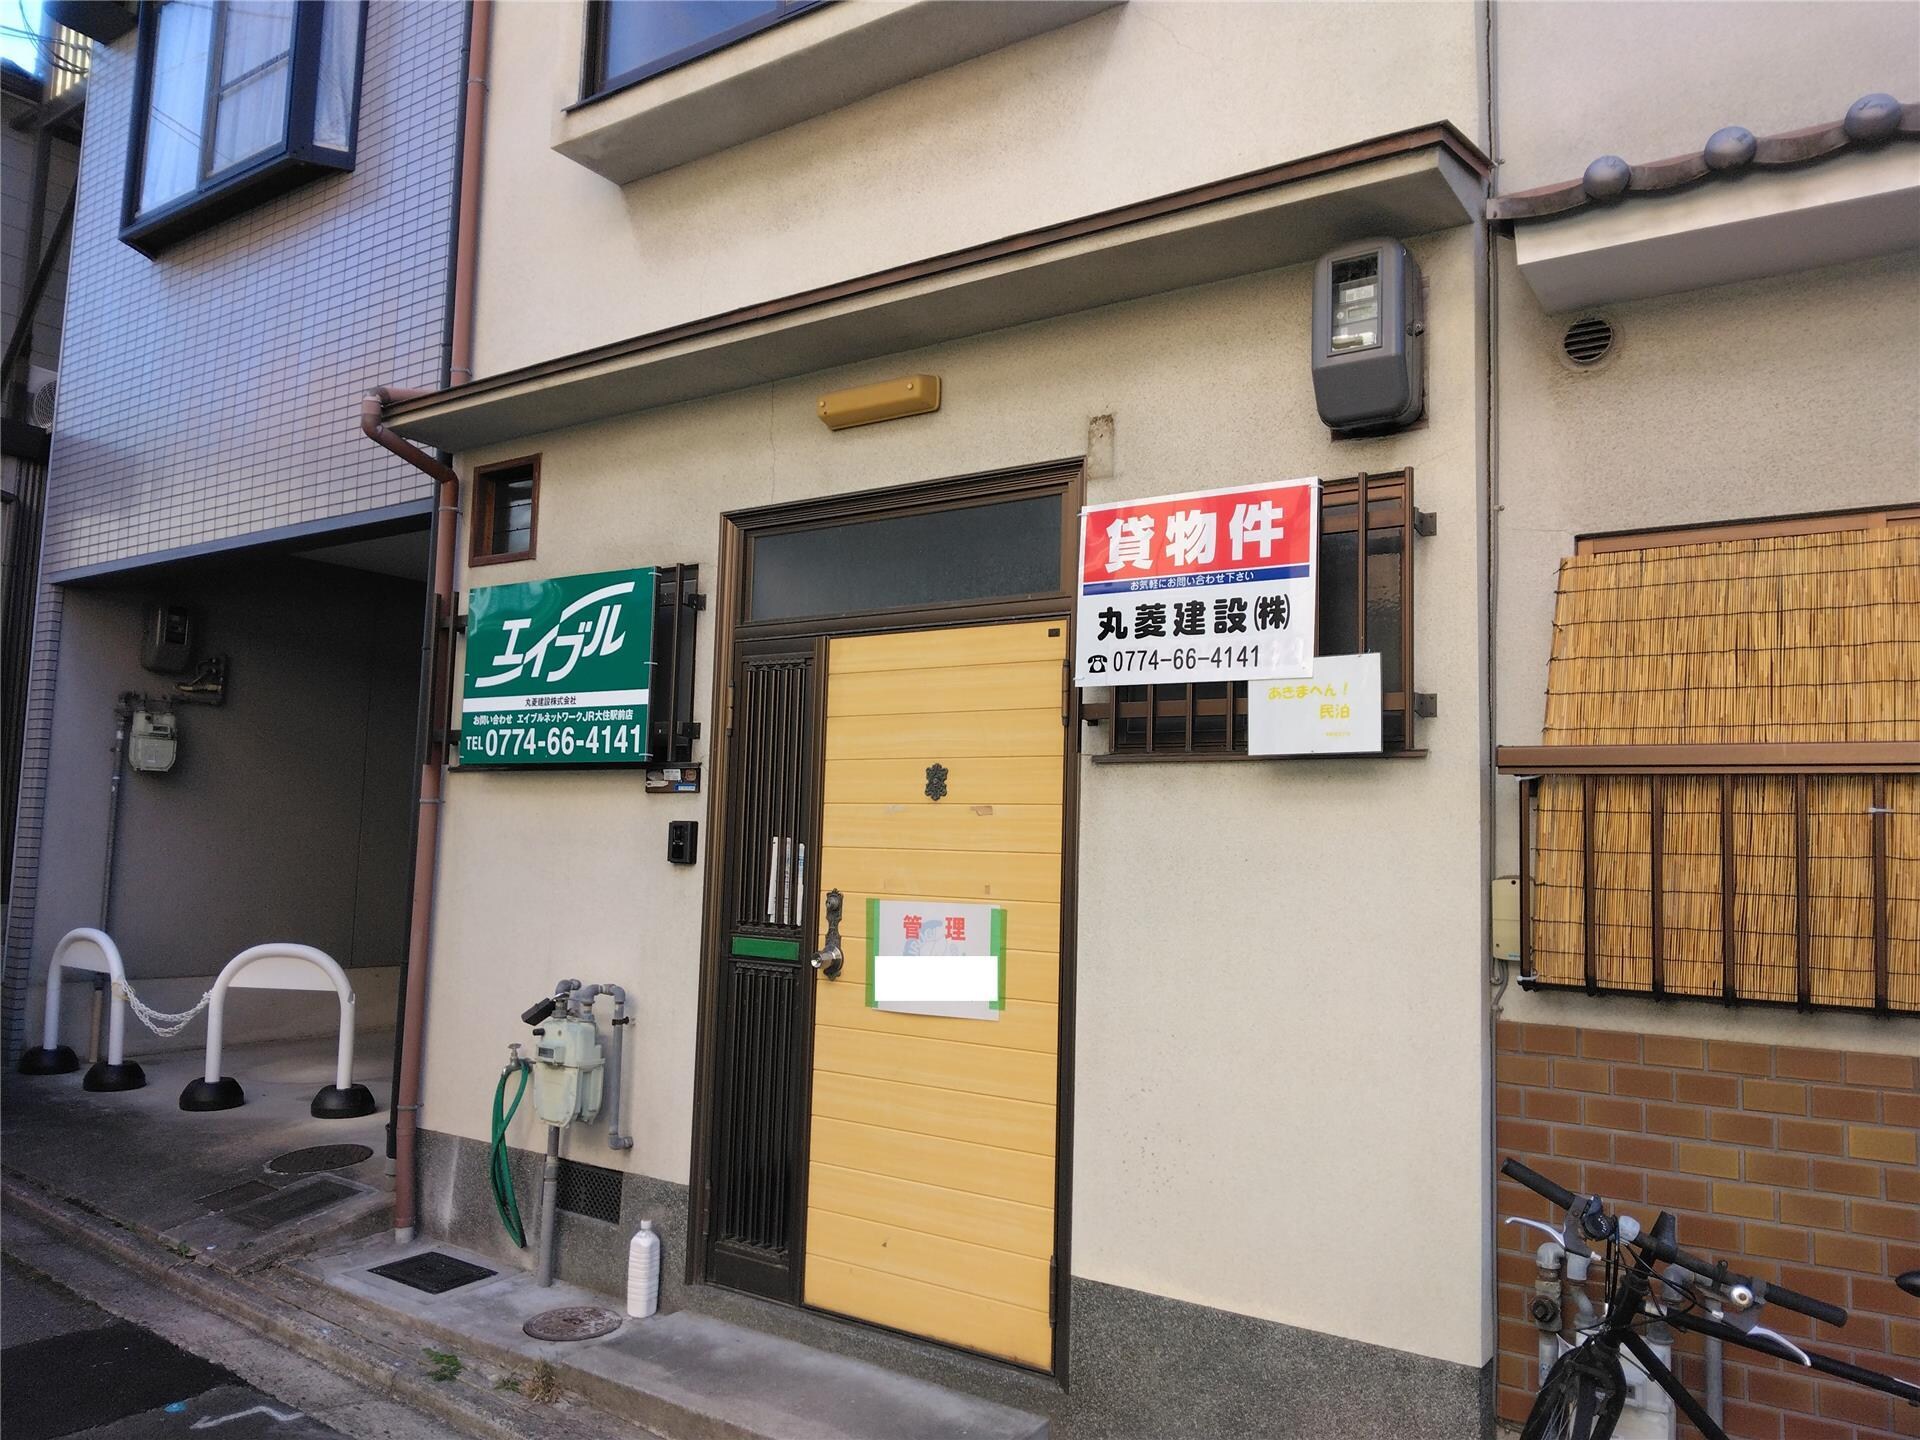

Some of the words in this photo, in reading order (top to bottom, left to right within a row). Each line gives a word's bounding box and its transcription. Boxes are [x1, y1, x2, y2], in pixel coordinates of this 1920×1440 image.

[1104, 500, 1285, 574] 貸物件
[1130, 571, 1255, 591] お気軽にお問い合わせ下さい
[475, 581, 636, 688] エイブル
[1113, 645, 1260, 672] 0774-66-4141
[525, 695, 577, 707] 丸菱建設株式会社
[1319, 703, 1350, 719] 民泊
[473, 714, 513, 726] お問い合わせ
[466, 736, 484, 750] TEL
[485, 724, 641, 757] 0774-66-4141
